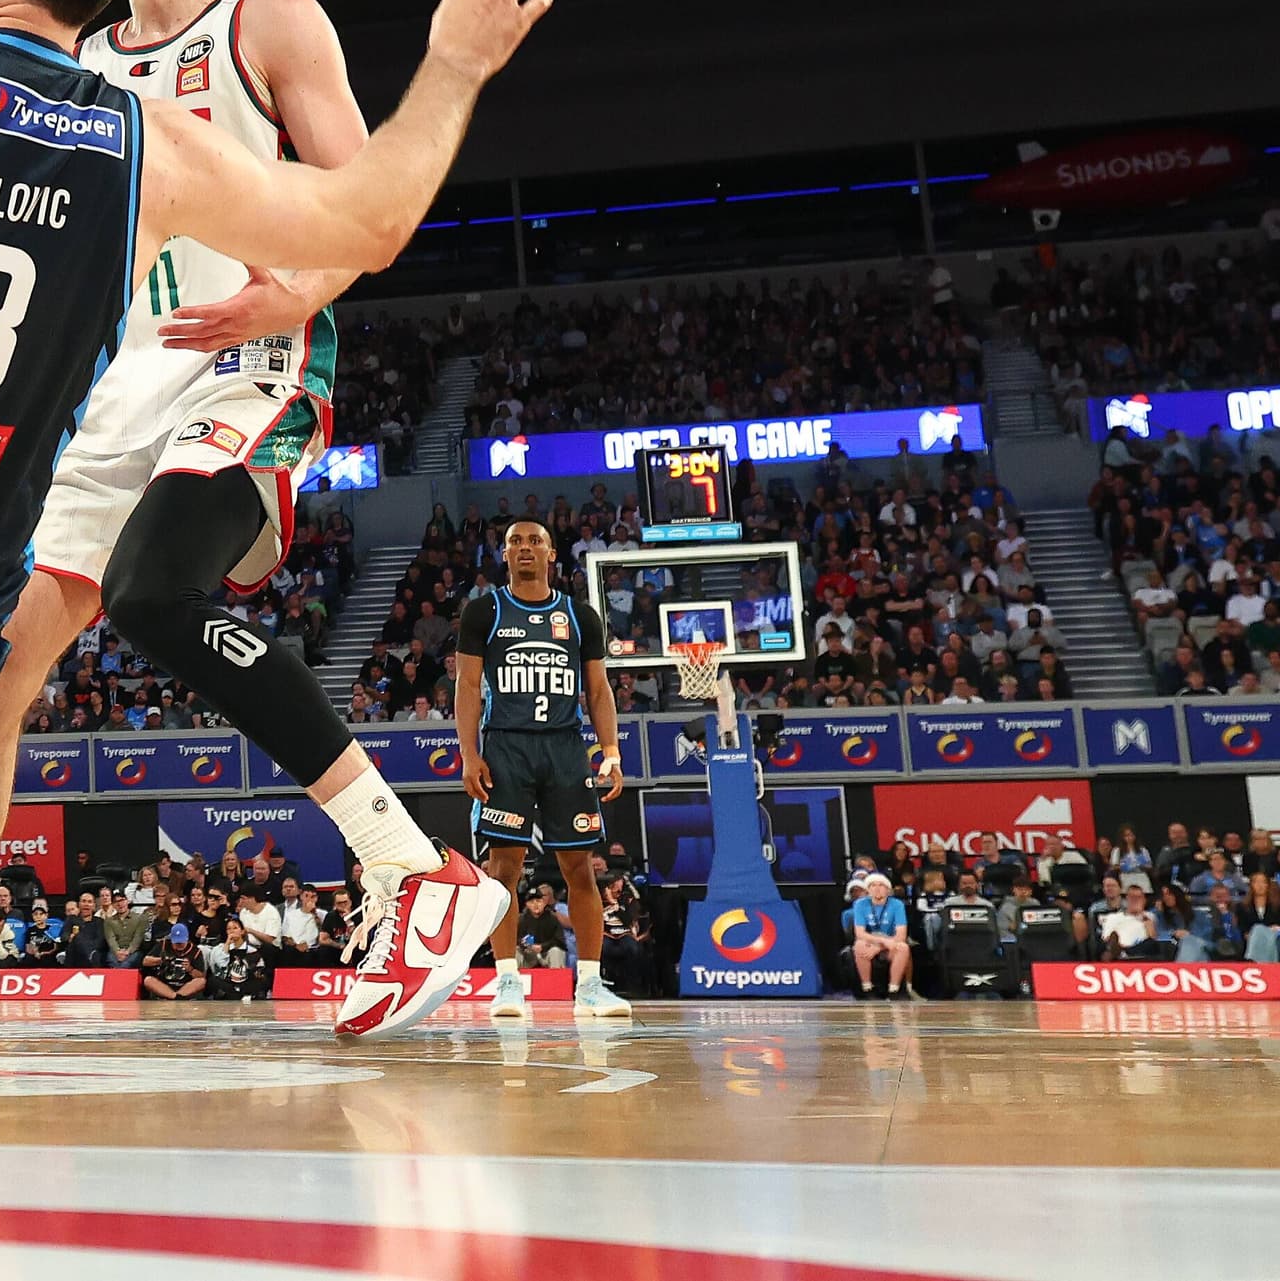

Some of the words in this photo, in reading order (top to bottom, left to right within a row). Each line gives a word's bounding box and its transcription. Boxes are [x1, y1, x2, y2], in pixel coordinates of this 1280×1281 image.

[746, 419, 832, 460] GAME
[669, 449, 720, 478] 3:04
[691, 475, 717, 515] 7
[497, 666, 575, 696] UNITED
[534, 695, 550, 722] 2
[824, 723, 888, 738] Tyrepower
[919, 720, 984, 733] Tyrepower
[996, 718, 1062, 731] Tyrepower
[177, 743, 232, 756] Tyrepower
[413, 736, 460, 748] Tyrepow
[27, 749, 81, 762] Tyrepower
[102, 746, 157, 759] Tyrepower
[203, 807, 296, 825] Tyrepower
[691, 966, 803, 990] Tyrepower
[1073, 964, 1268, 995] SIMONDS
